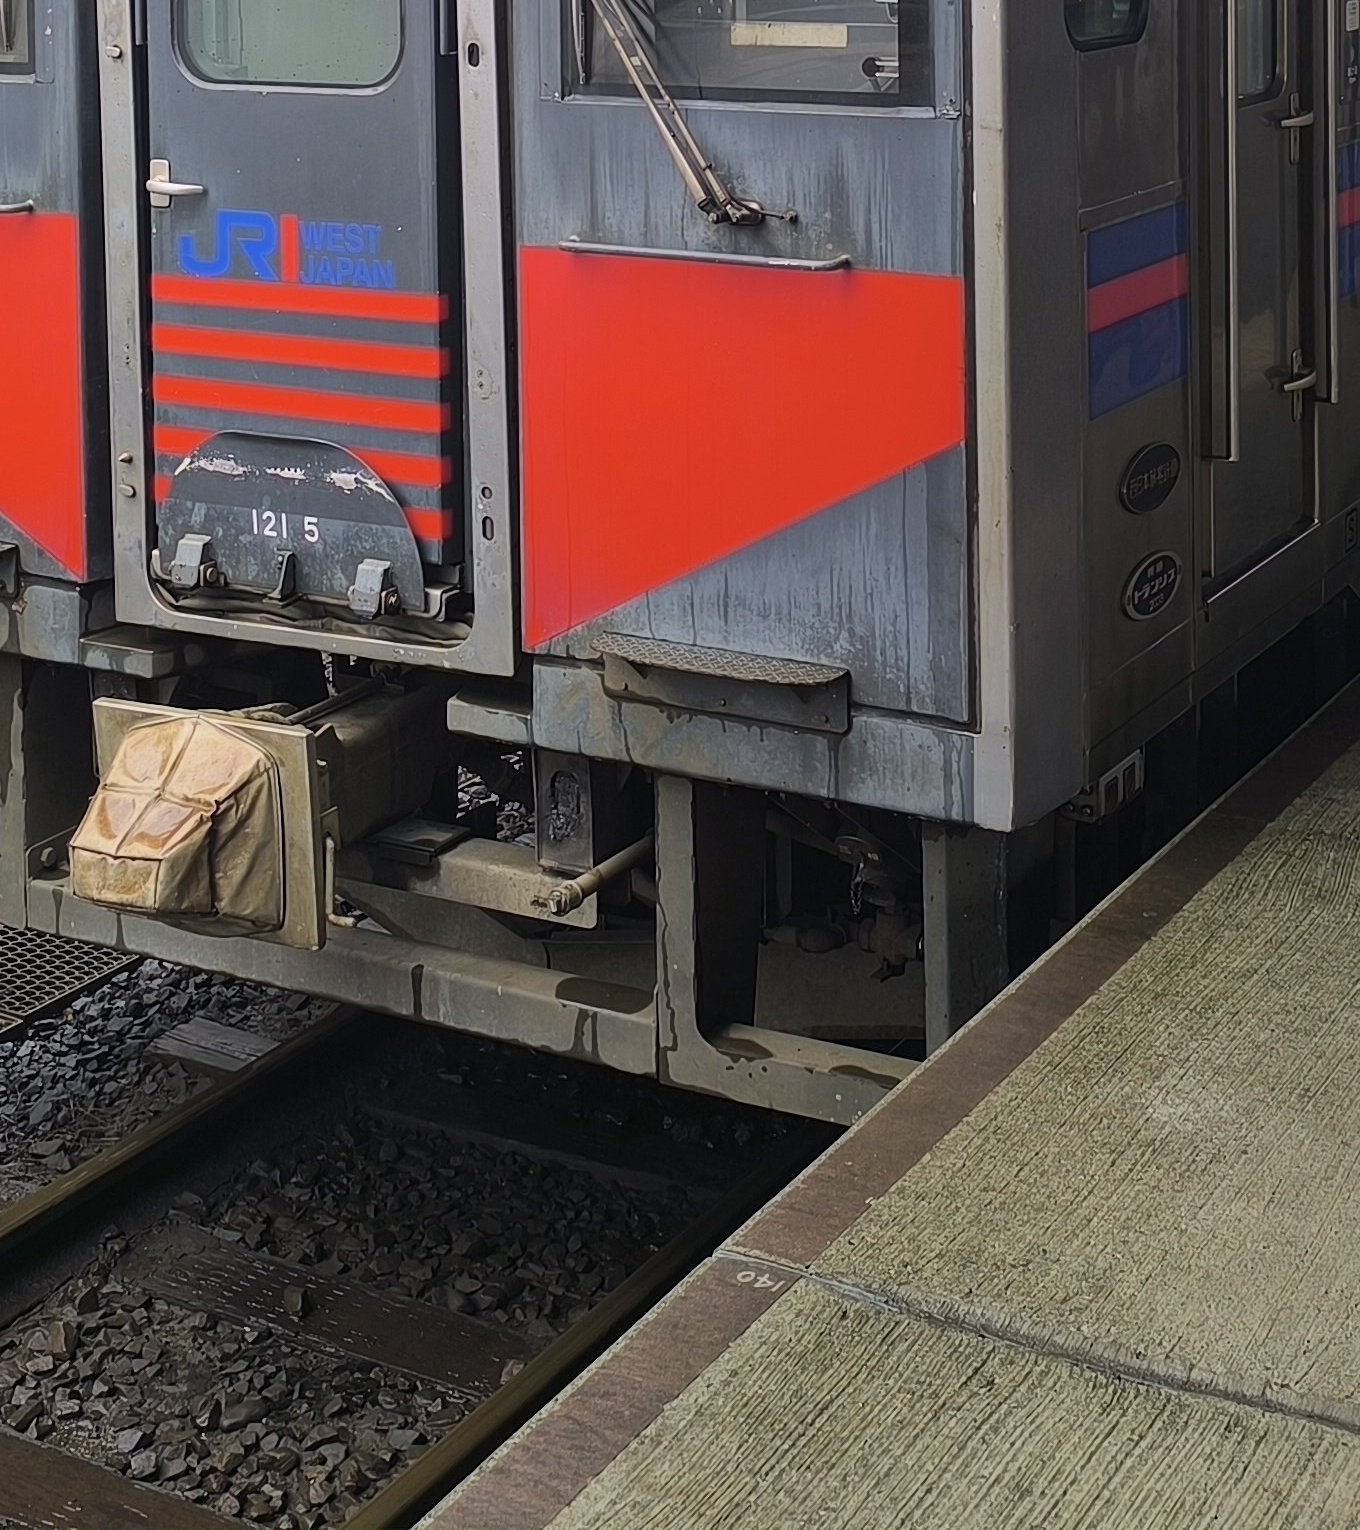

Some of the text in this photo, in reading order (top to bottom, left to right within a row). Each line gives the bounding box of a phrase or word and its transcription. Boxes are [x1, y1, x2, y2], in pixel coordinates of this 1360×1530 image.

[178, 208, 277, 280] JR
[298, 220, 382, 254] WEST
[299, 256, 396, 289] JAPAN
[251, 508, 319, 543] 121 5
